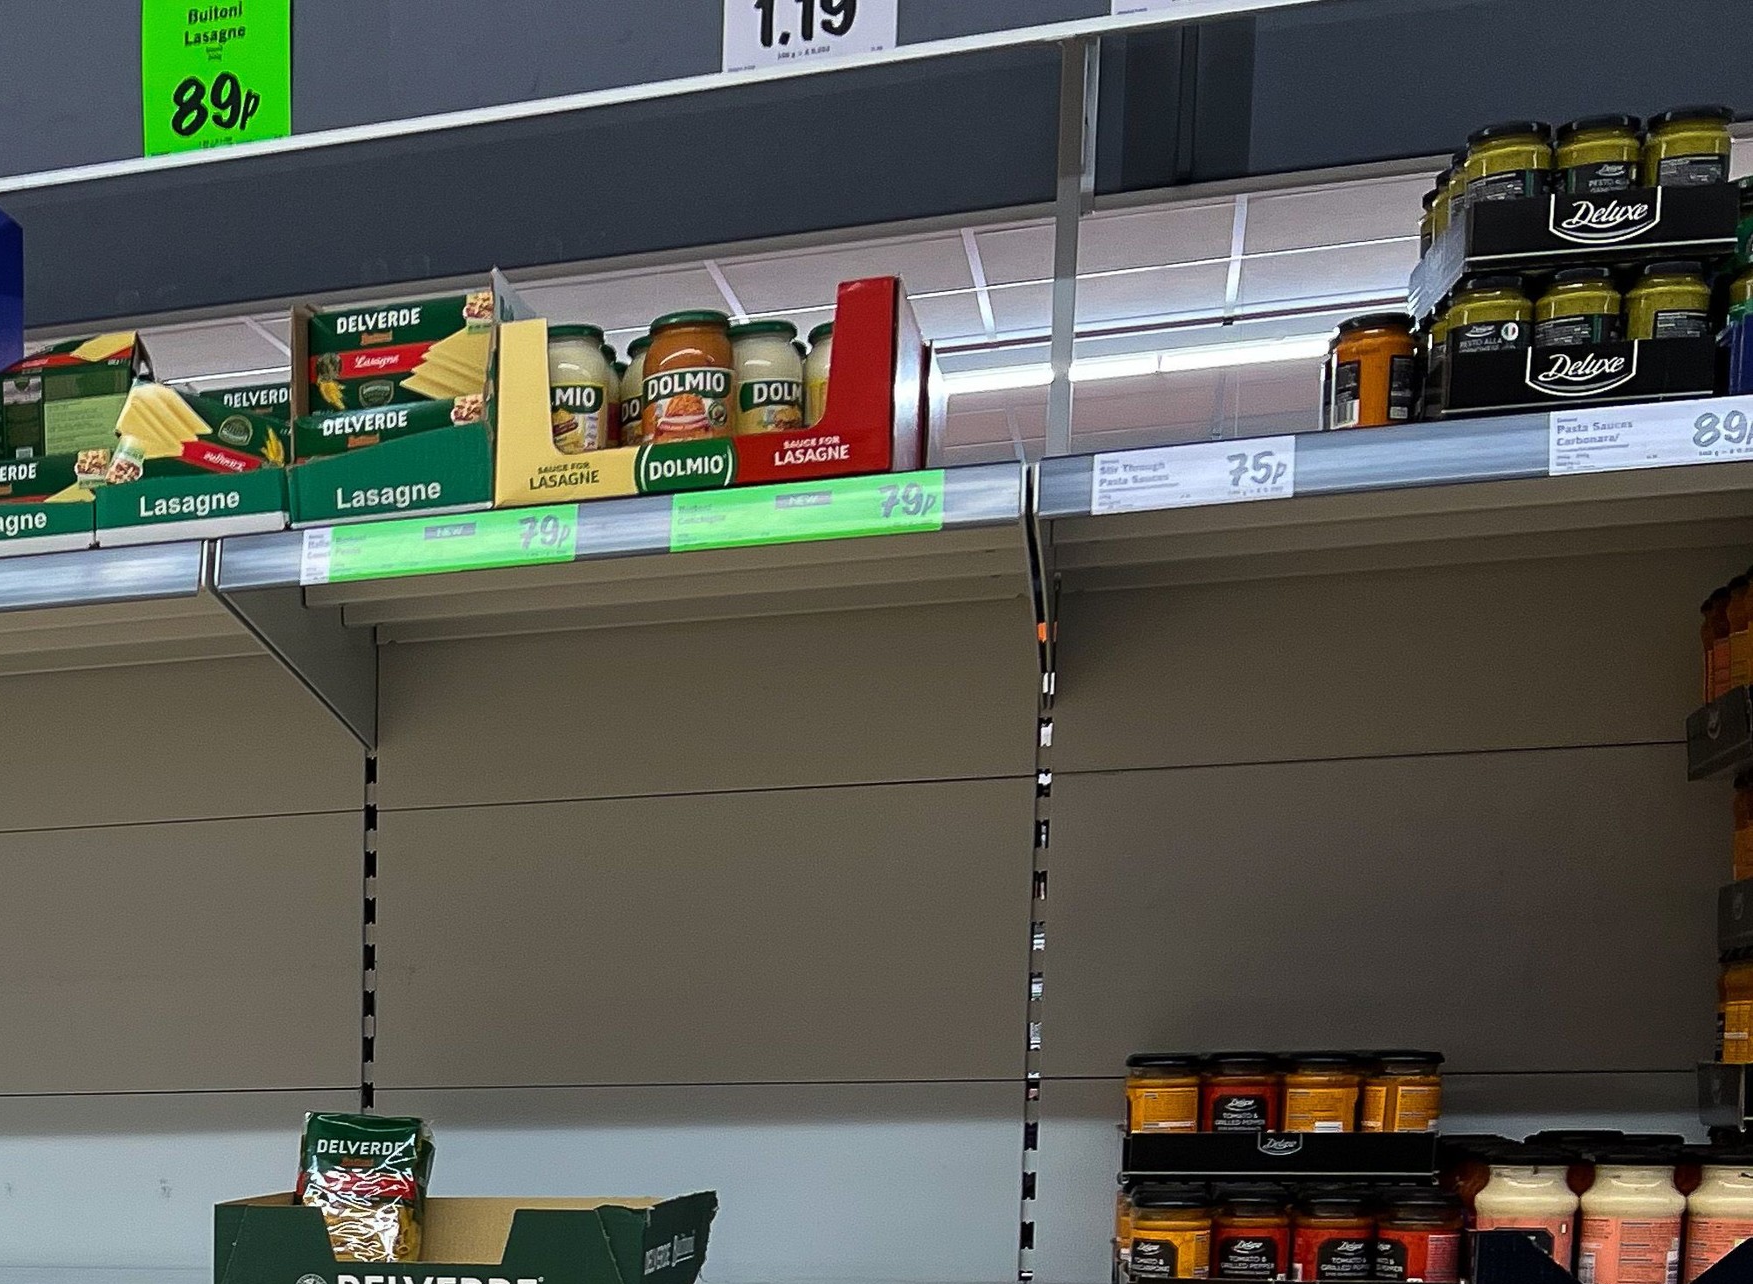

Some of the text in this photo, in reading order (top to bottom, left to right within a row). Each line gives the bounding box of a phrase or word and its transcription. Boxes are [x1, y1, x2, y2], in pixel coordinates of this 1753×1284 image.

[188, 0, 243, 25] Buitoni
[754, 0, 857, 48] 1.19
[184, 26, 246, 46] Lasagne
[171, 71, 261, 137] 89p
[1562, 199, 1648, 228] Deluxe
[336, 306, 421, 335] DELVERDE
[355, 354, 400, 370] Lasagne
[1538, 352, 1625, 381] Deluxe
[554, 386, 595, 407] MIO
[647, 371, 726, 401] DOLMIO
[322, 409, 409, 436] DELVERDE
[1557, 421, 1633, 434] Pasta Sauces
[783, 436, 841, 450] SAUCE FOR
[1556, 433, 1620, 447] Carbonara/
[774, 444, 850, 466] LASAGNE
[529, 469, 600, 490] LASAGNE
[537, 462, 590, 475] SAUCE FOR
[649, 455, 725, 481] DOLMIO
[1099, 474, 1170, 487] Pasta Sauces
[1227, 451, 1287, 487] 75p
[140, 490, 240, 517] Lasagne
[337, 481, 442, 509] Lasagne
[877, 482, 937, 518] 79p
[518, 514, 570, 550] 79p
[316, 1139, 406, 1157] DELVERDE
[1262, 1137, 1298, 1150] Deluxe
